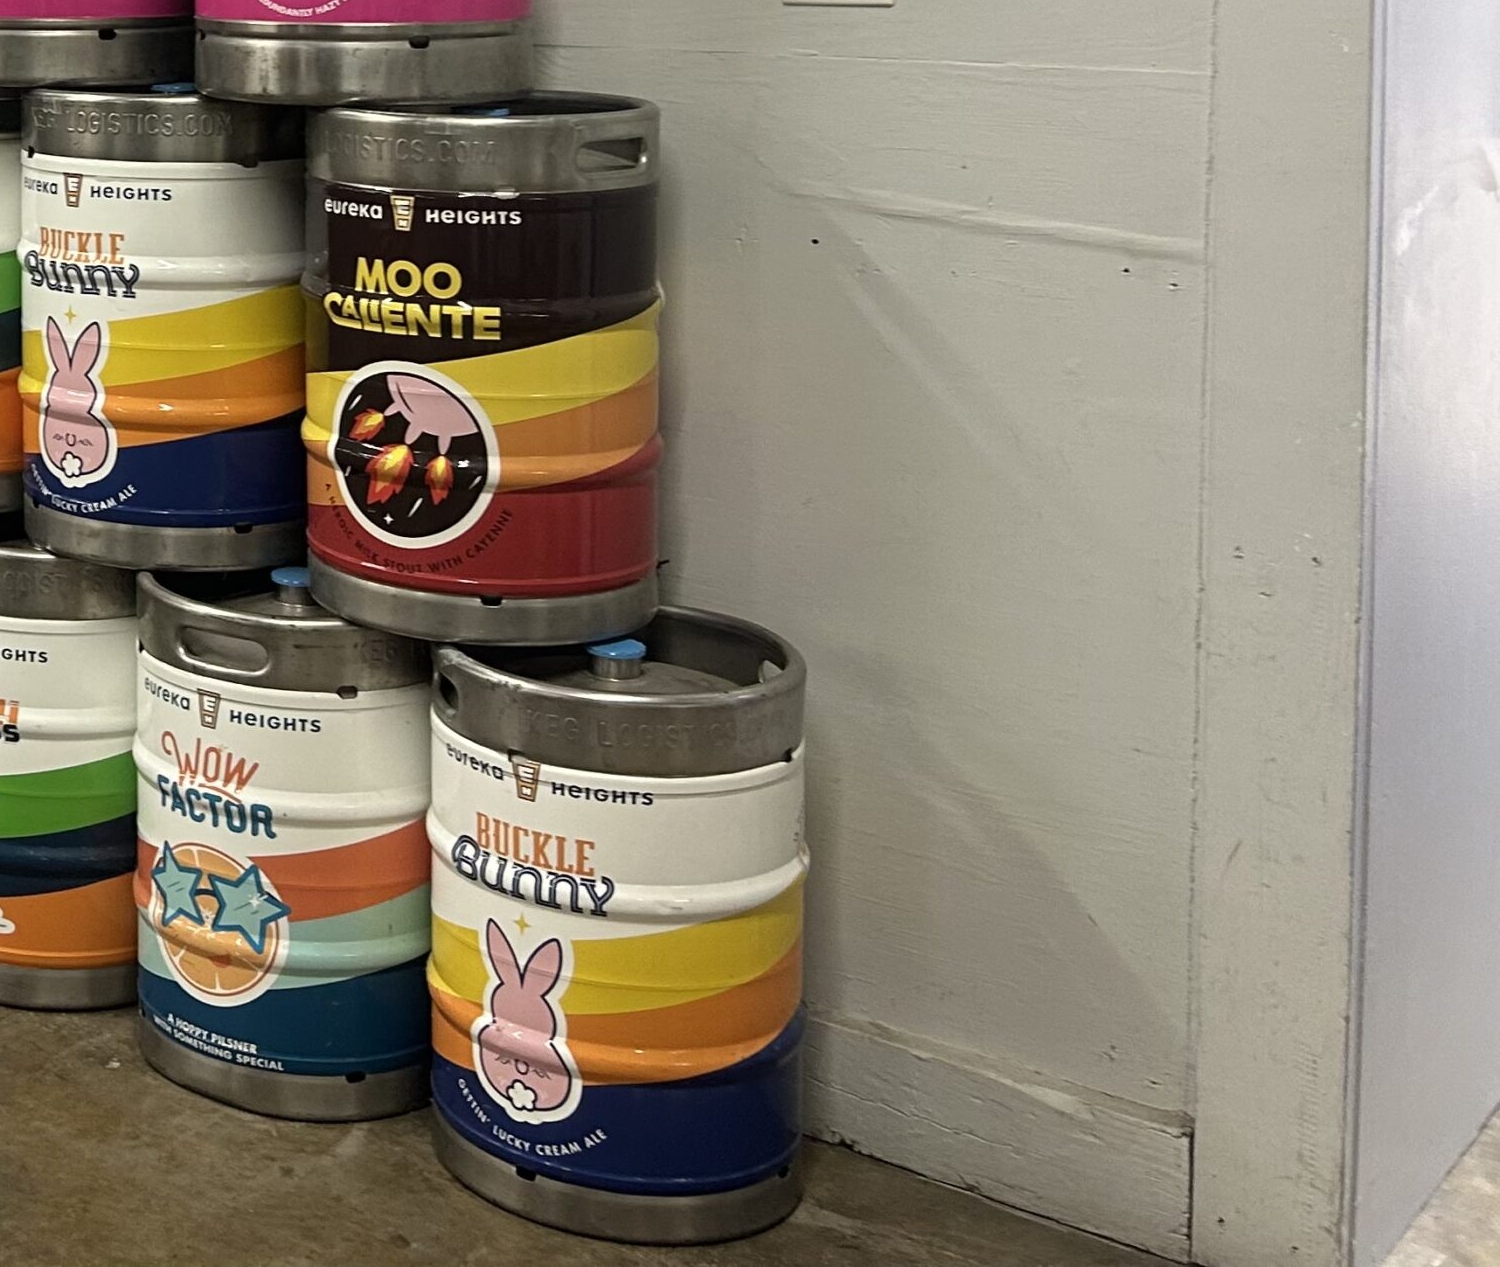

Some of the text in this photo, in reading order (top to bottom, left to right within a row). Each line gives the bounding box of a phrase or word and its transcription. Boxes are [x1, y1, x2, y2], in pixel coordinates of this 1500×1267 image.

[324, 198, 383, 220] eureka
[40, 226, 125, 265] BUCKLE
[354, 256, 462, 300] MOO
[323, 291, 501, 341] CALIENTE
[81, 497, 118, 513] CREAM
[118, 484, 138, 503] ALE
[383, 557, 423, 574] STOUT
[427, 554, 463, 574] WITH
[464, 508, 514, 559] CAYENNE
[144, 676, 191, 711] eureka
[161, 730, 260, 794] WOW
[446, 742, 504, 781] eureka
[157, 774, 277, 839] FACTOR
[476, 811, 596, 877] BUCKLE
[210, 1033, 258, 1055] PILSNER
[235, 1053, 285, 1072] SPECIAL
[492, 1125, 532, 1153] LUCKY
[534, 1141, 583, 1157] CREAM
[584, 1128, 609, 1150] ALE
